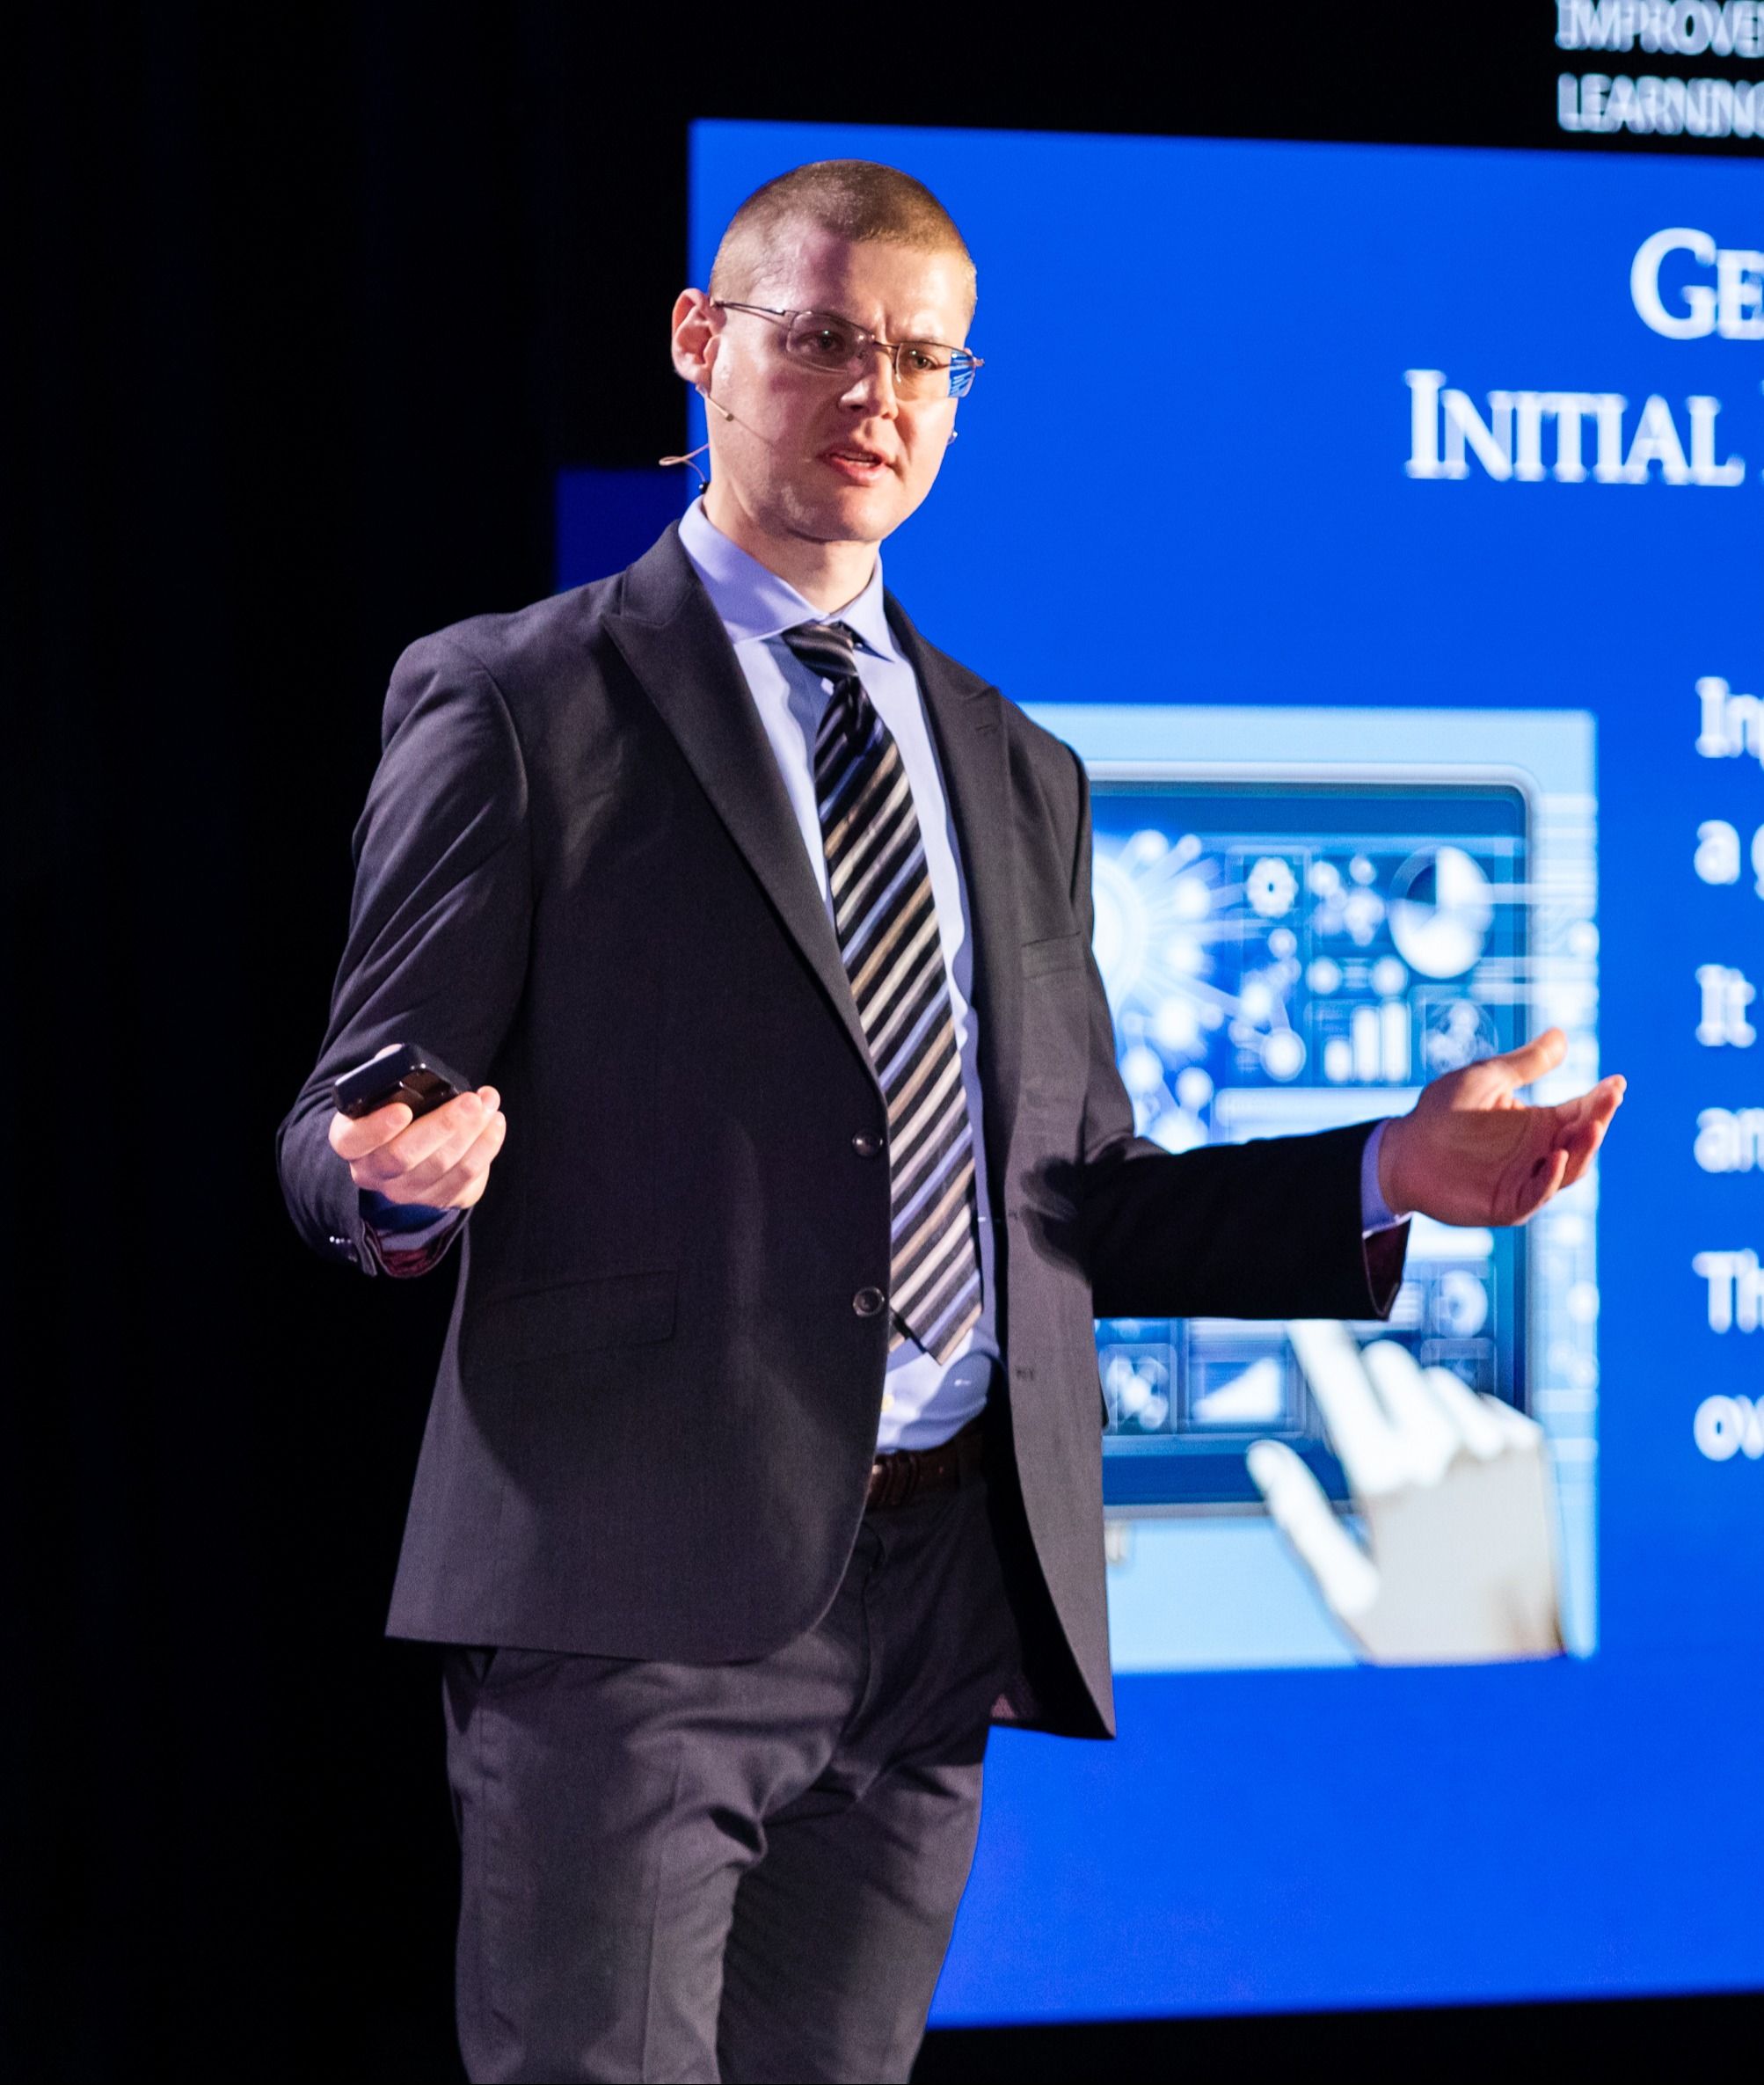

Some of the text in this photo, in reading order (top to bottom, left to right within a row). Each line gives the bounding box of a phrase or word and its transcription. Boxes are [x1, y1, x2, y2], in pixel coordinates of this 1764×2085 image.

[1556, 0, 1764, 57] IMPROVE
[1403, 369, 1746, 486] INITIAL
[1695, 676, 1764, 769] In
[1694, 820, 1740, 886] a
[1695, 965, 1756, 1048] It
